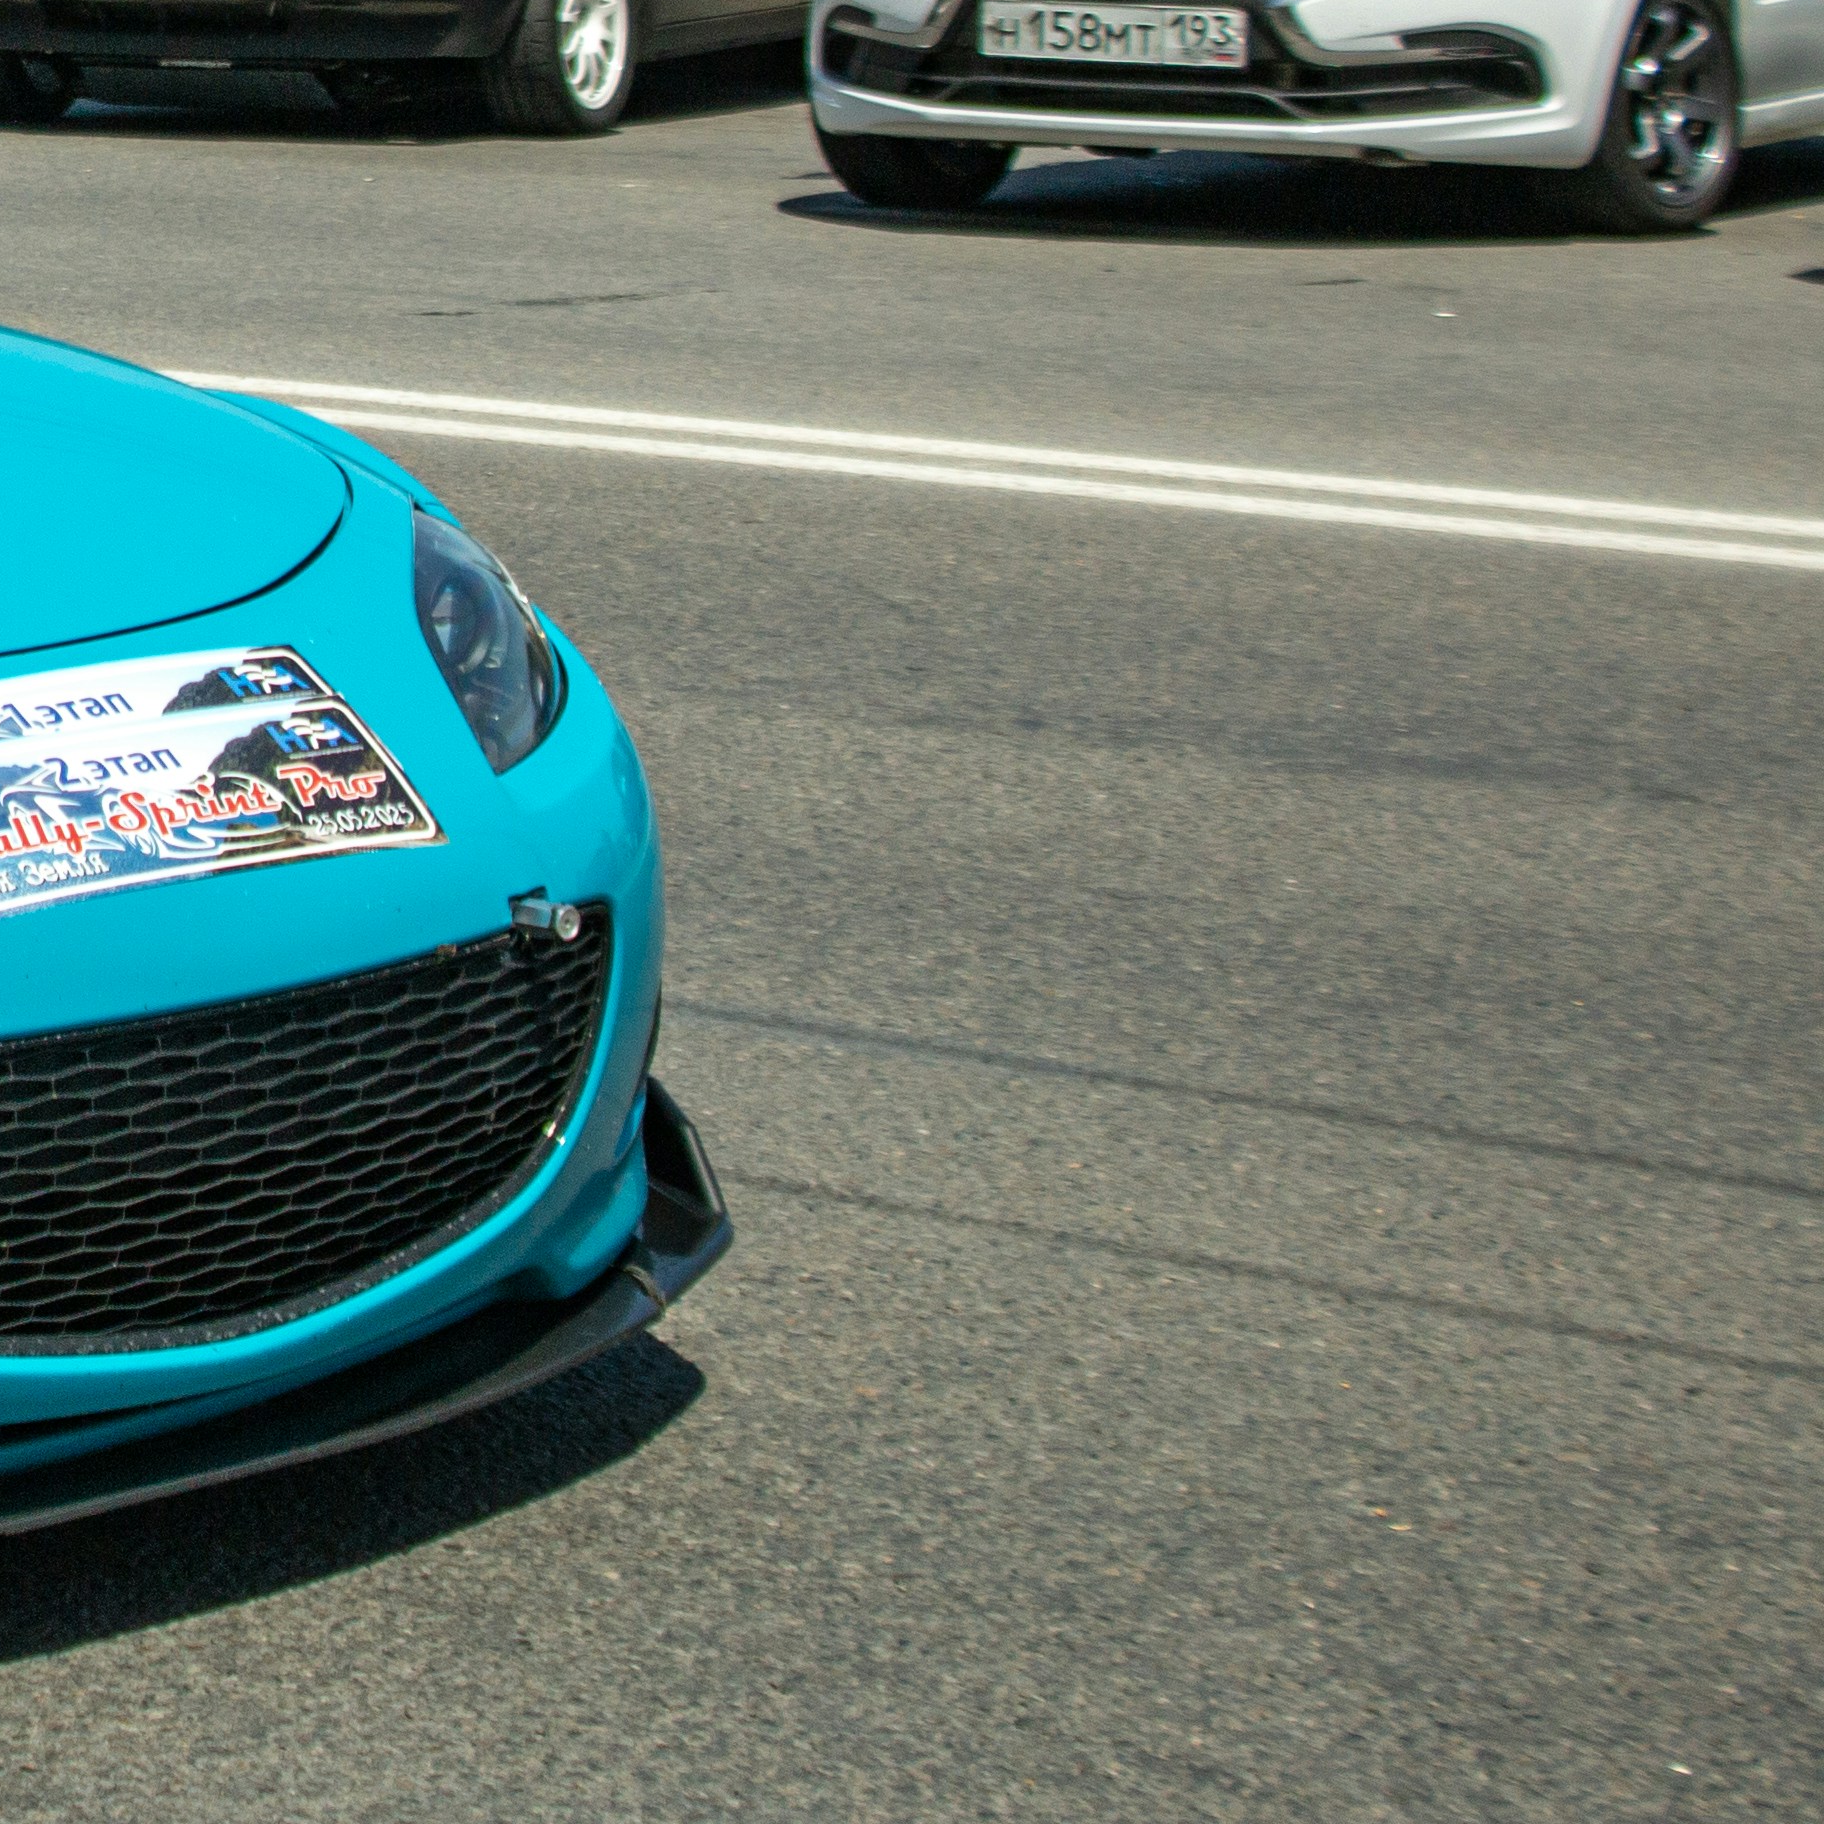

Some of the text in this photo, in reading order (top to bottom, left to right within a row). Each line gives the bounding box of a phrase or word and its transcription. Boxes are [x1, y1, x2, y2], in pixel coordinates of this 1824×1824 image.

[1169, 13, 1233, 46] 193
[35, 692, 134, 725] этап
[83, 748, 183, 780] этап
[279, 766, 386, 806] Pro
[309, 803, 415, 836] 25.05.2025
[18, 853, 110, 886] Земля
